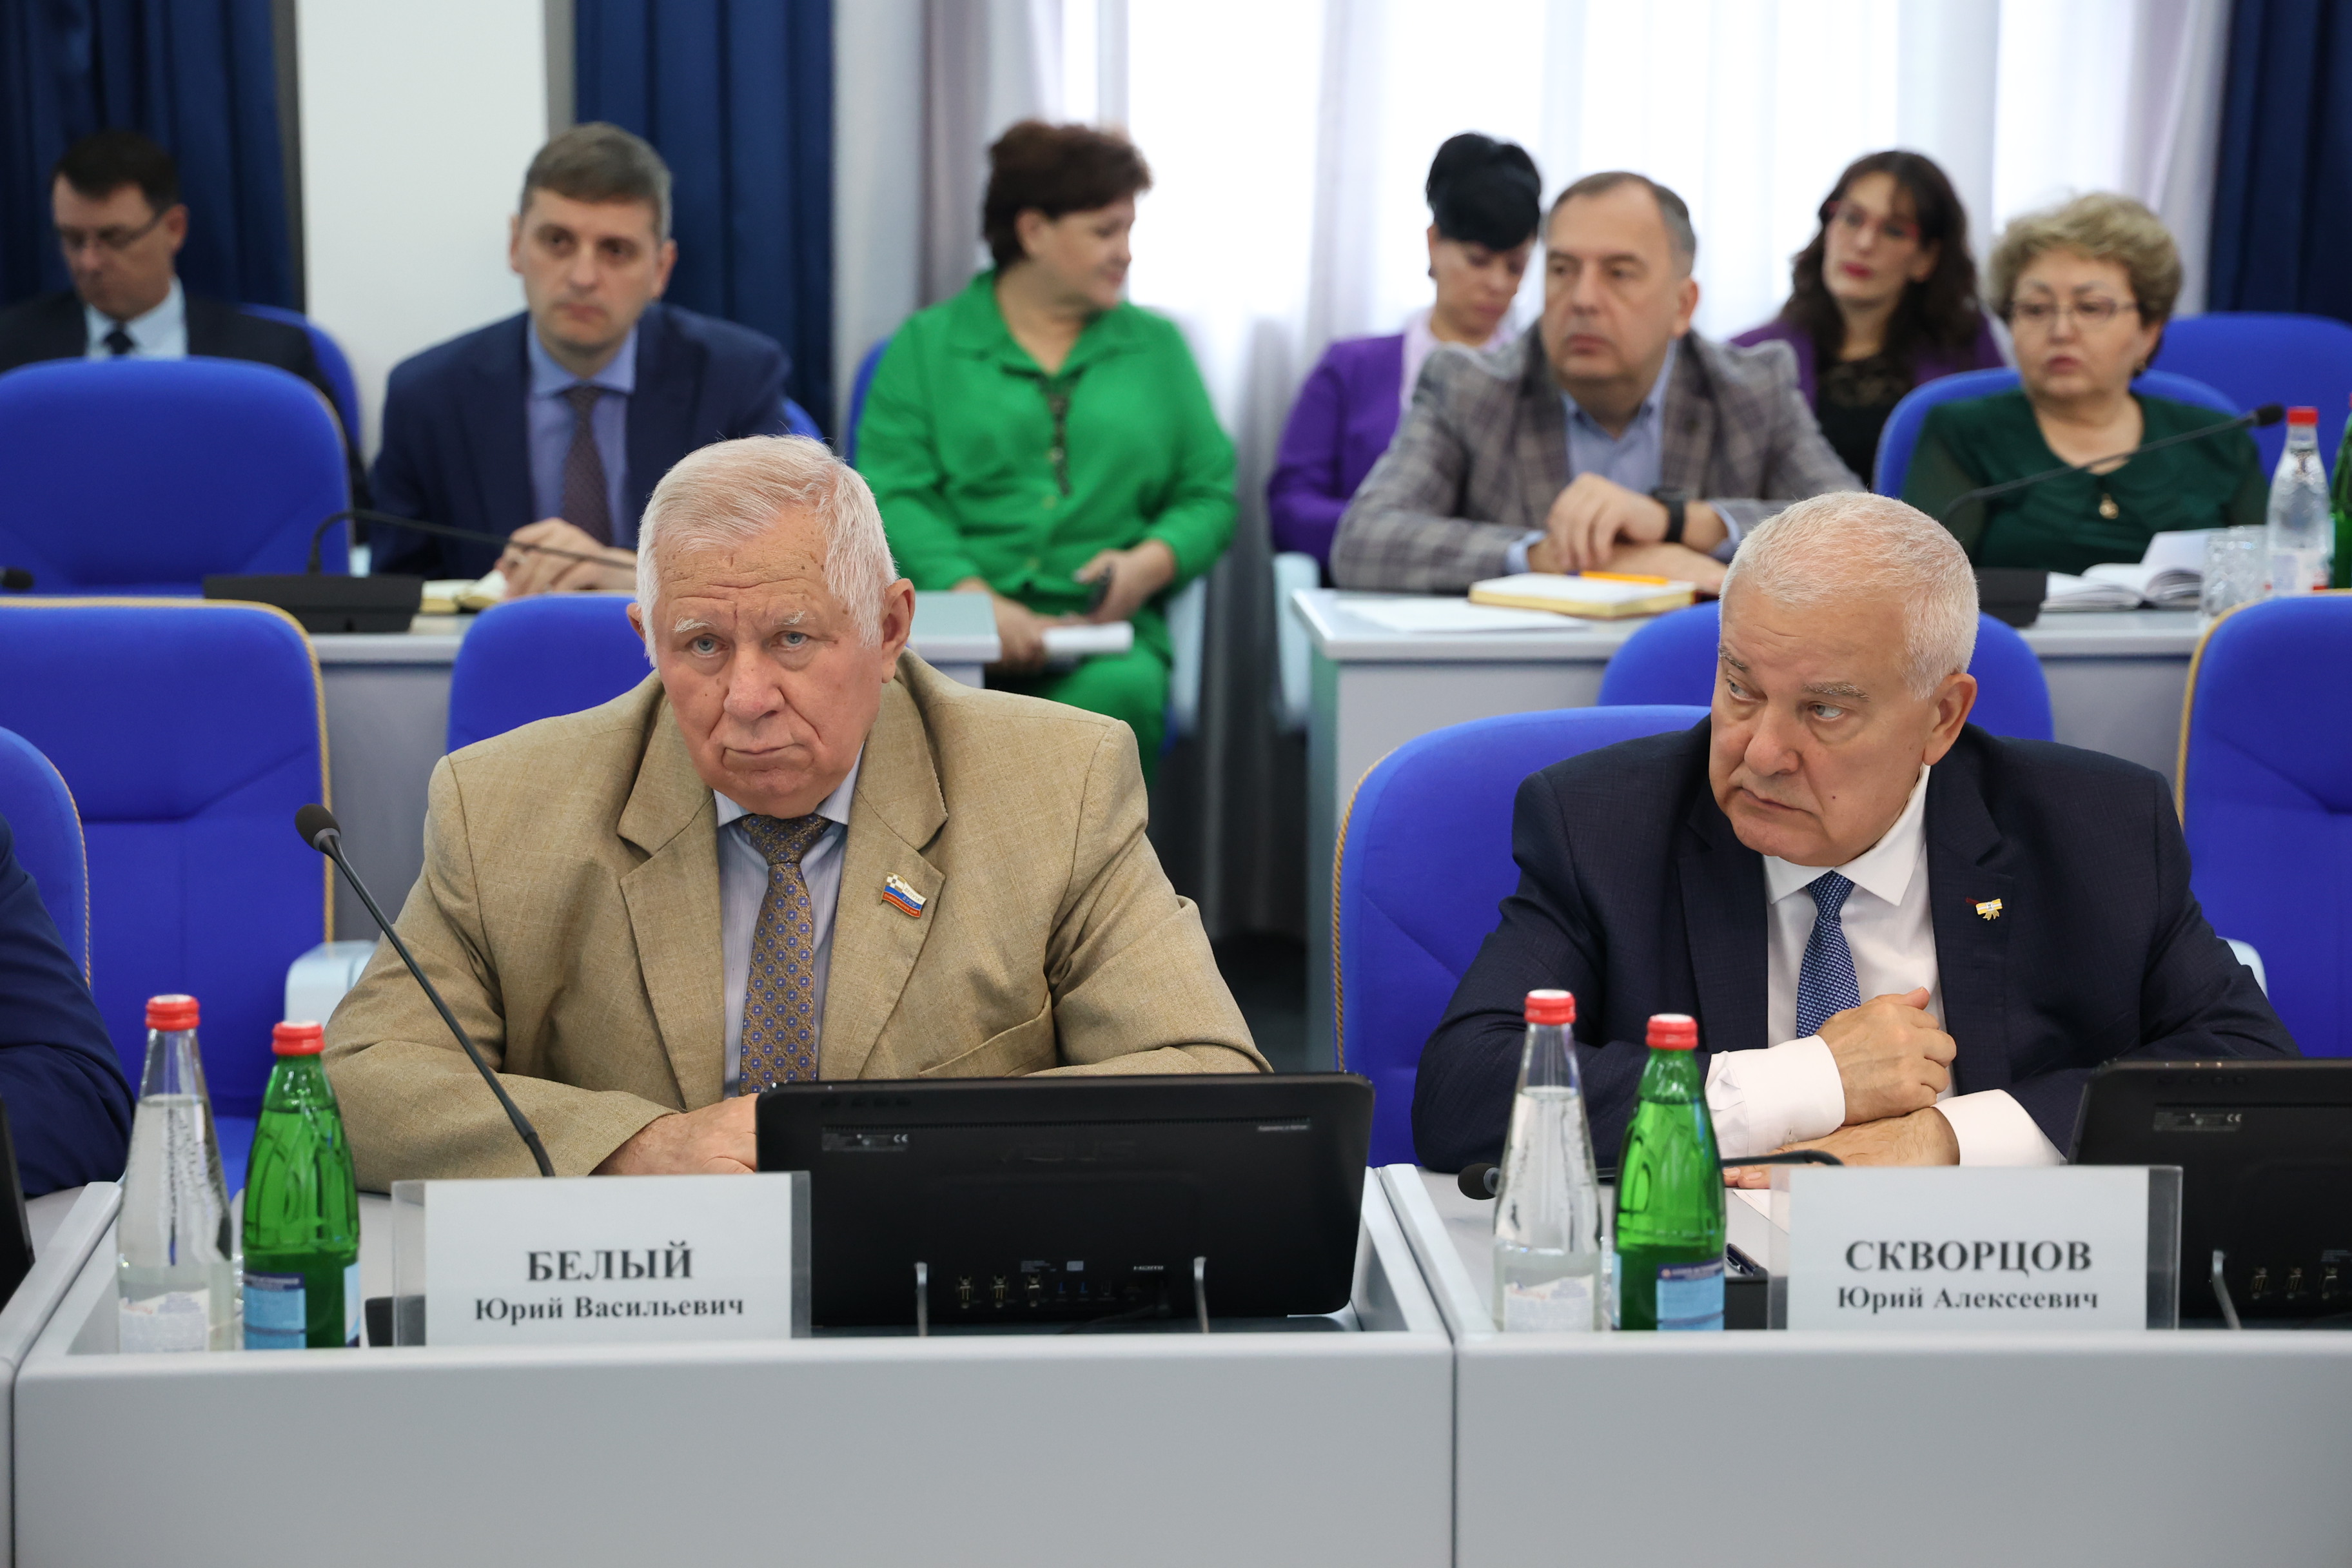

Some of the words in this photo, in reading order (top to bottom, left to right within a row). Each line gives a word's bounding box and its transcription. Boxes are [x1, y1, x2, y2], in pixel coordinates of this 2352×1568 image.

[904, 888, 923, 902] ДЕПУТАТ
[527, 1240, 693, 1282] БЕЛЫЙ
[1845, 1240, 2092, 1278] СКВОРЦОВ
[475, 1297, 564, 1326] Юрий
[575, 1296, 744, 1319] Васильевич
[1838, 1286, 1923, 1315] Юрий
[1934, 1287, 2099, 1309] Алексеевич
